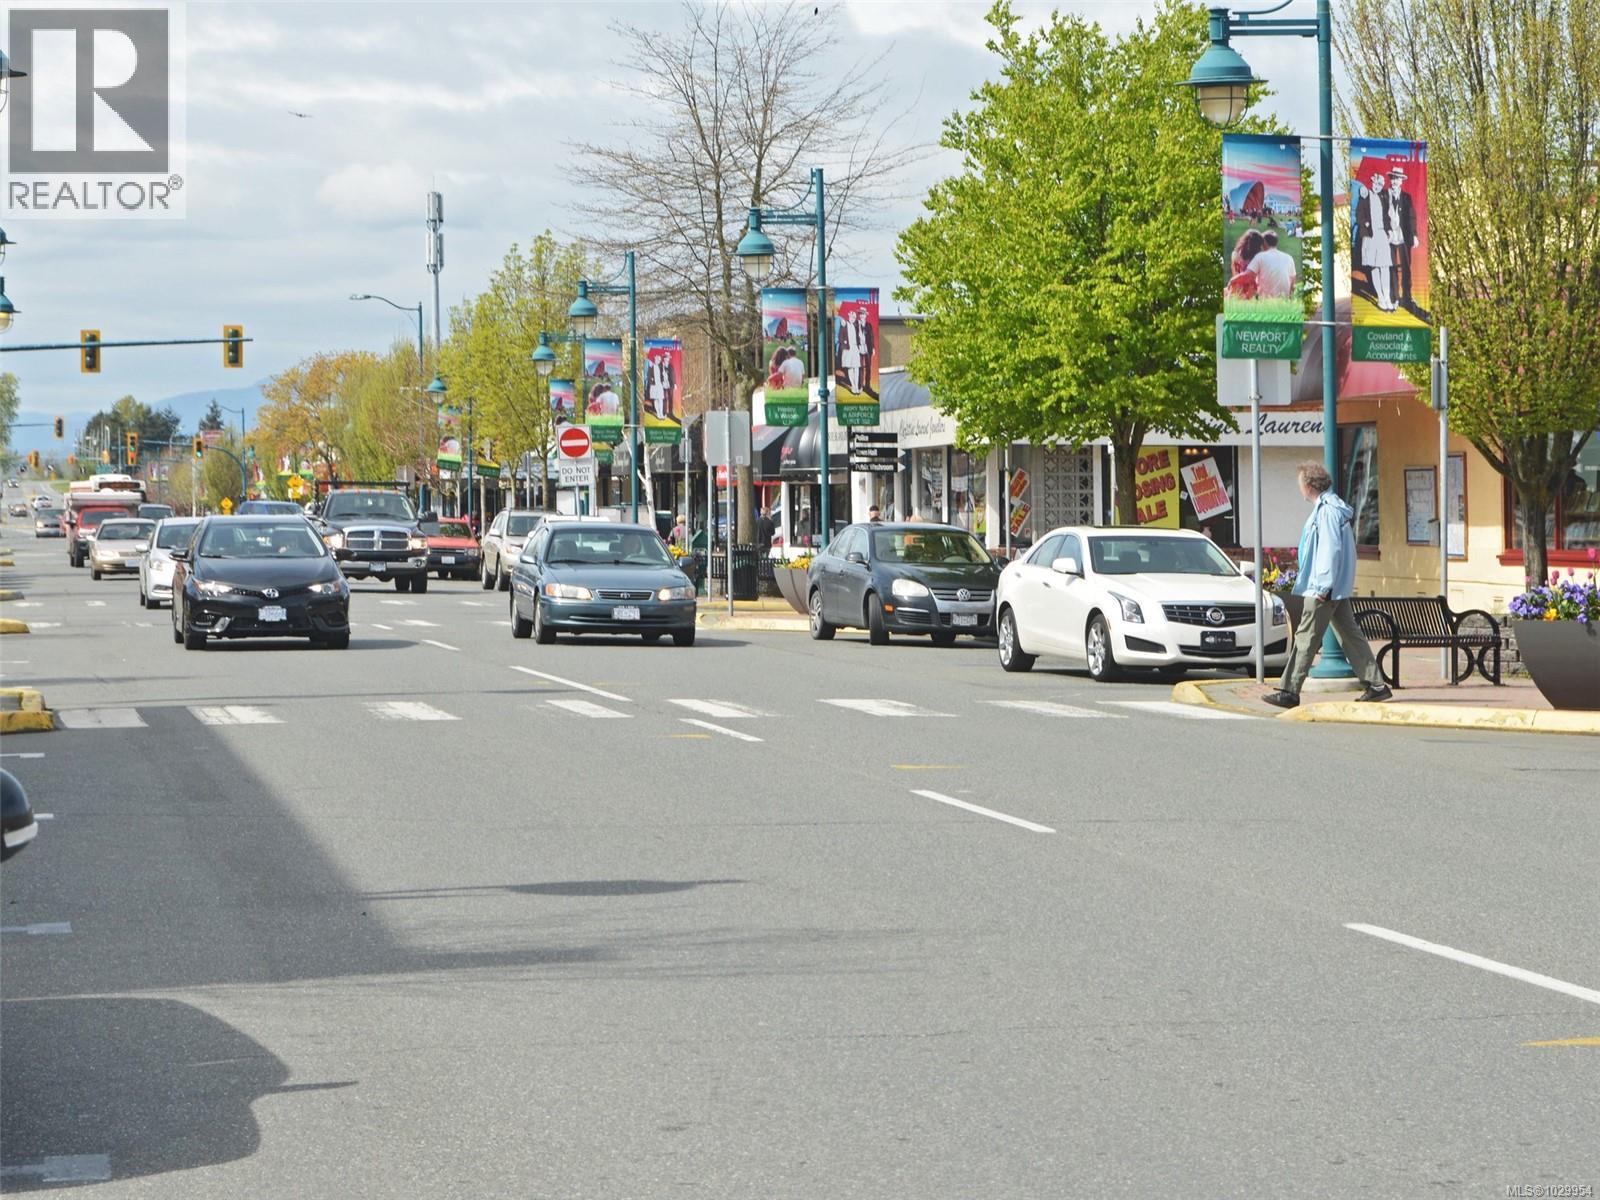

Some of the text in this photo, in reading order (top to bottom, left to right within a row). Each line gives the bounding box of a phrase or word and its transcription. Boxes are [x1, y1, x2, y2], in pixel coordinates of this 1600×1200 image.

[1235, 331, 1288, 342] NEWPORT
[1367, 332, 1404, 341] Cowland
[1241, 343, 1280, 354] REALTY
[1369, 342, 1414, 351] Associates
[1365, 351, 1417, 361] Accountants
[1245, 413, 1325, 435] Lauren
[1136, 449, 1171, 476] ORE
[562, 466, 591, 475] DO NOT
[565, 475, 589, 483] ENTER
[1010, 503, 1031, 533] SALE
[1136, 500, 1168, 525] ALE
